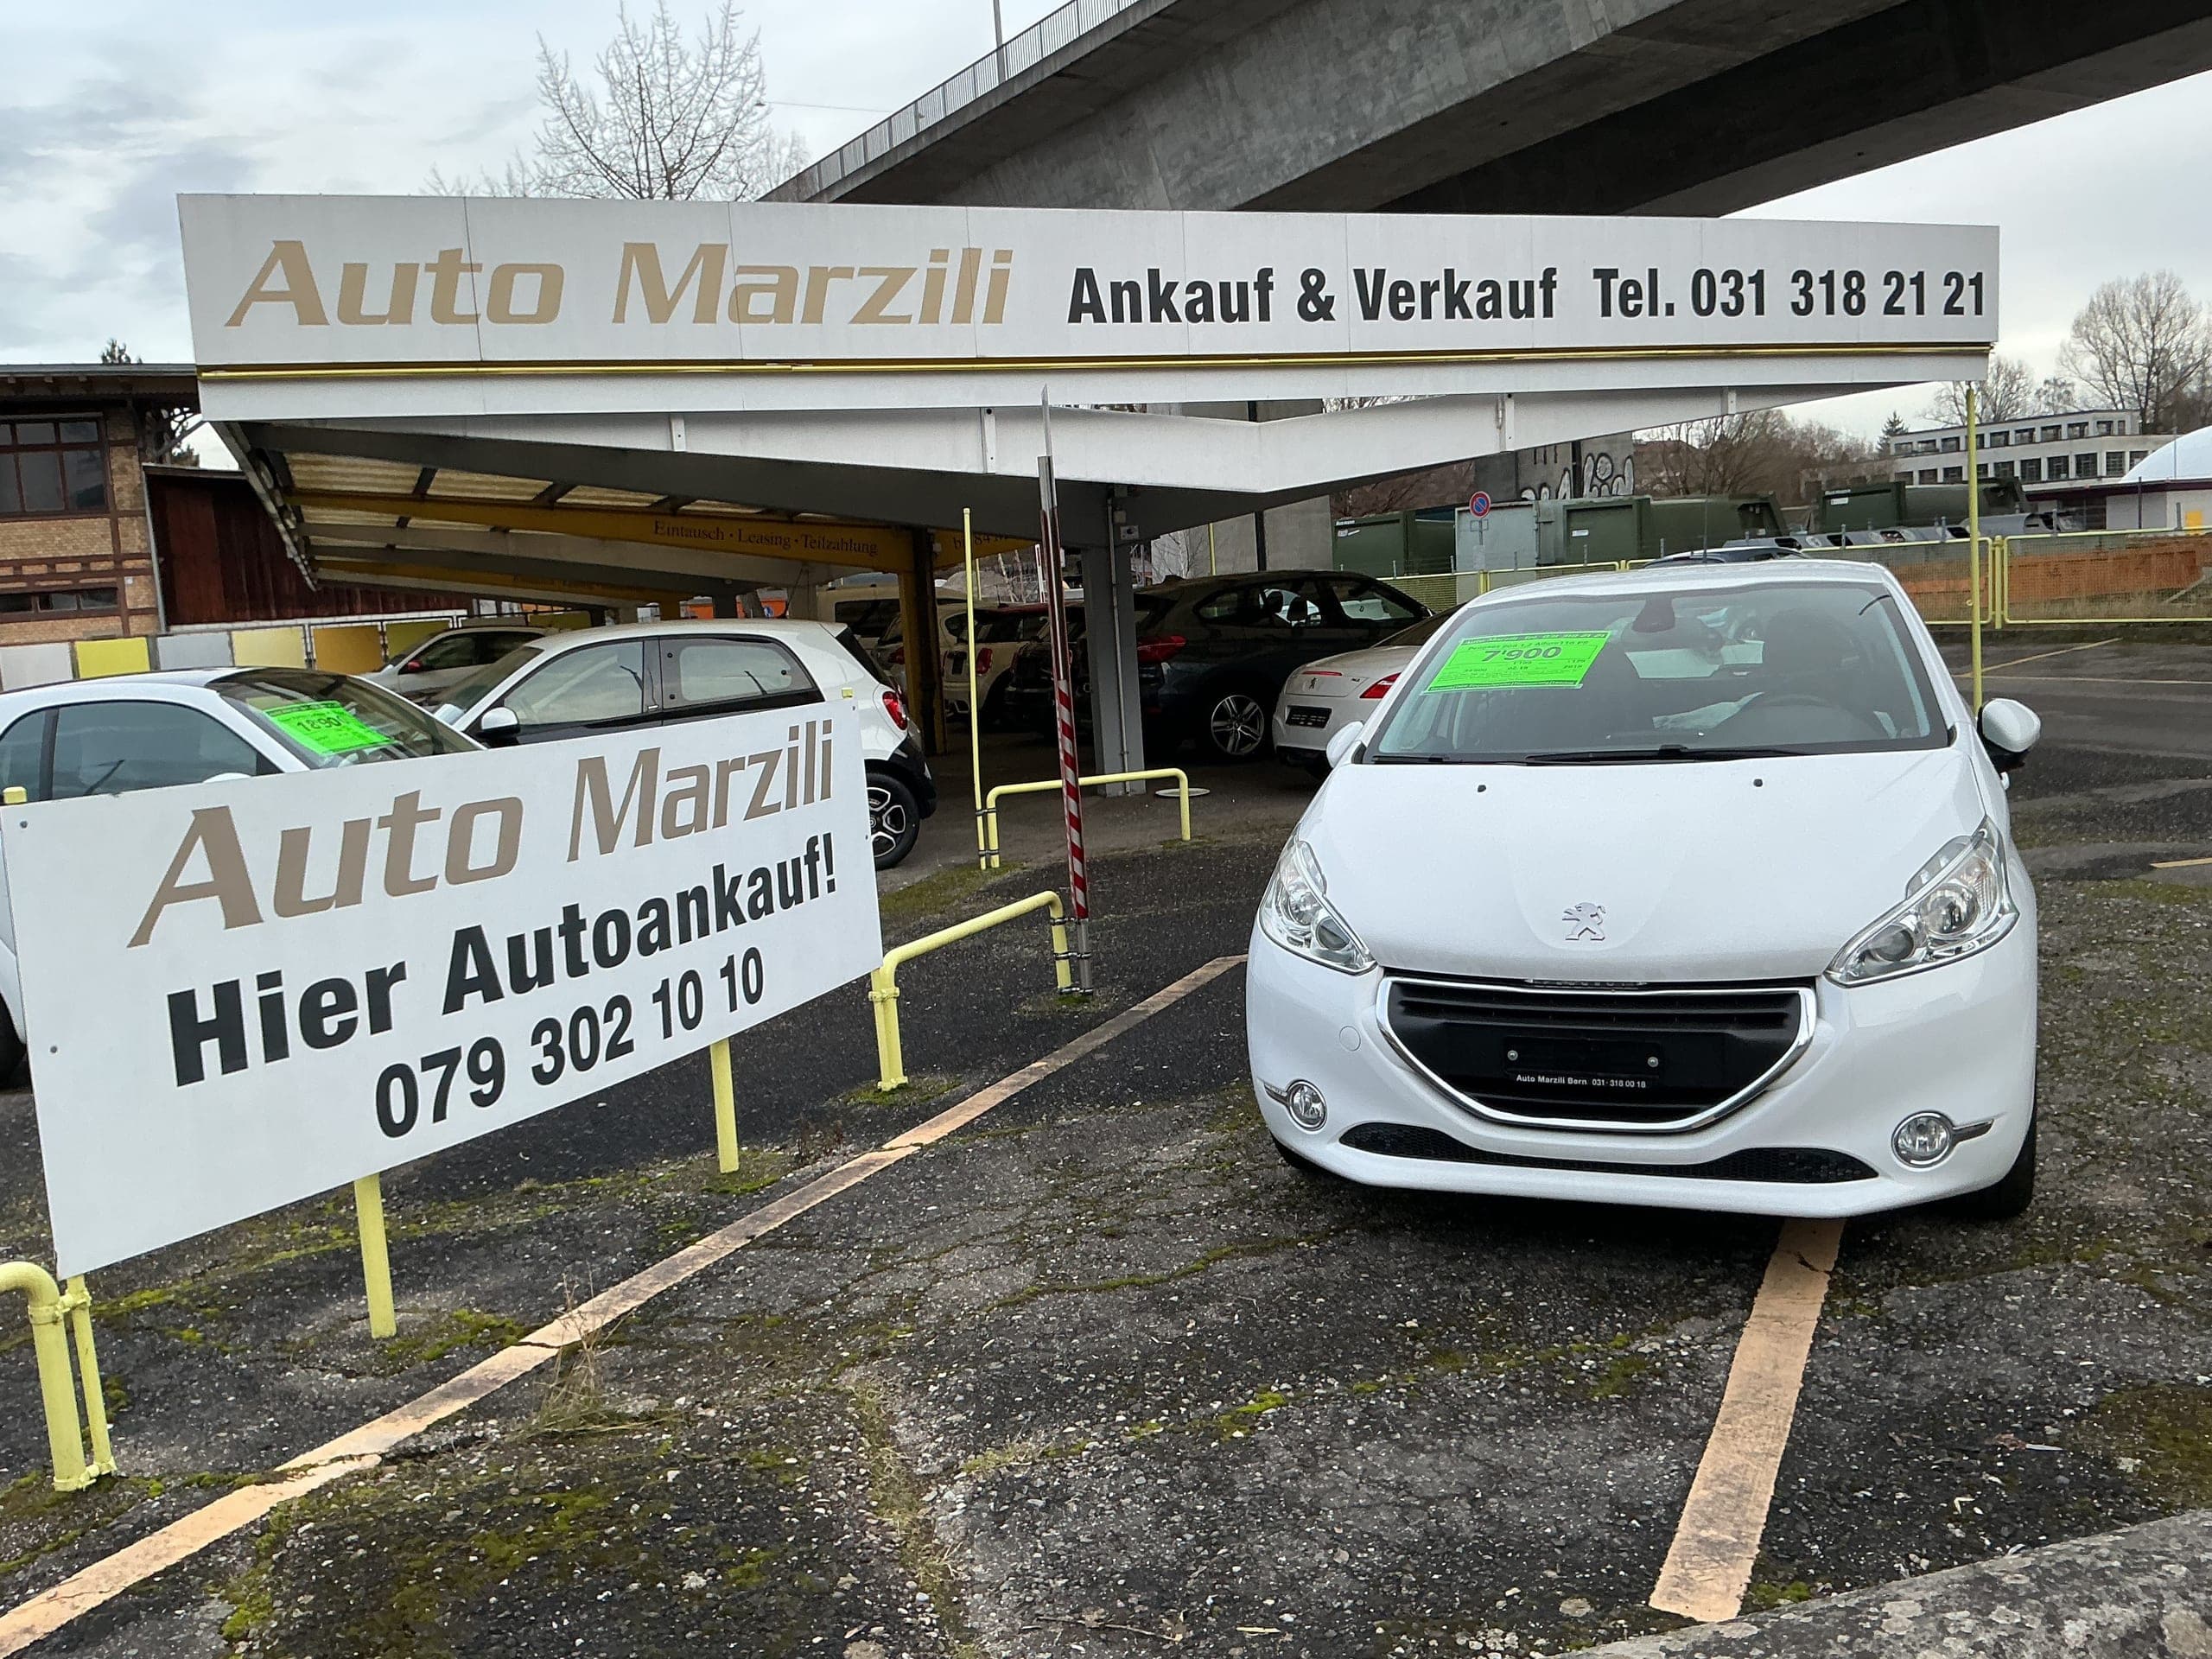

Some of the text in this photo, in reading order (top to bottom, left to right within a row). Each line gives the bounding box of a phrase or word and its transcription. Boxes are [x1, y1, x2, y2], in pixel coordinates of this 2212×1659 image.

[225, 239, 1984, 327] Auto Marzili Ankauf & Verkauf Tel. 031 318 21 21
[654, 519, 879, 556] Eintausch Leasing Teilzahlung
[1482, 646, 1562, 662] 7'900
[127, 719, 833, 948] Auto Marzili
[168, 832, 837, 1086] Hier Autoankauf!
[376, 947, 764, 1138] 079 302 10 10
[1516, 1074, 1535, 1083] Auto
[1537, 1075, 1566, 1084] Marzili
[1567, 1077, 1587, 1085] Bern
